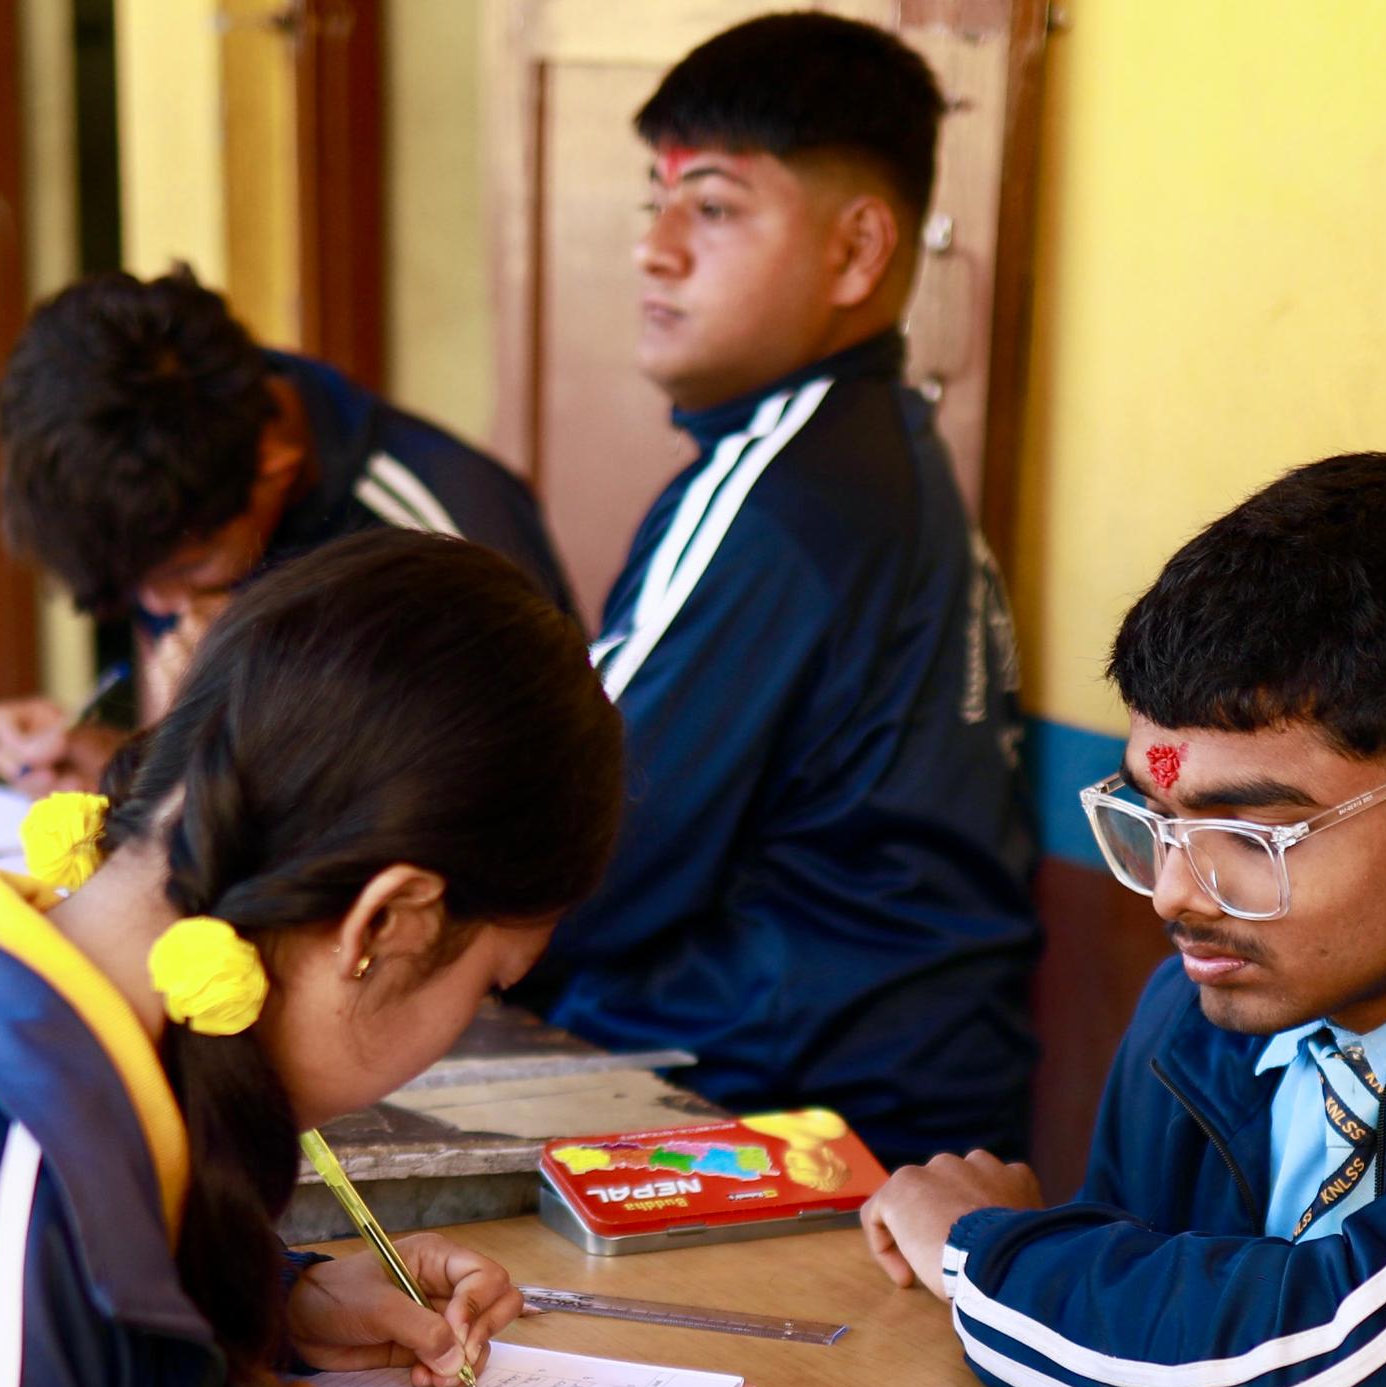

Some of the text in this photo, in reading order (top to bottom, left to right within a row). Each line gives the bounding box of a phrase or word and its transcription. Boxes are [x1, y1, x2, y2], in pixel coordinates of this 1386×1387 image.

[1325, 1096, 1366, 1141] KNLSS
[586, 1178, 703, 1203] NEPAL
[1319, 1157, 1366, 1206] KNLSS
[623, 1197, 689, 1212] Buddha
